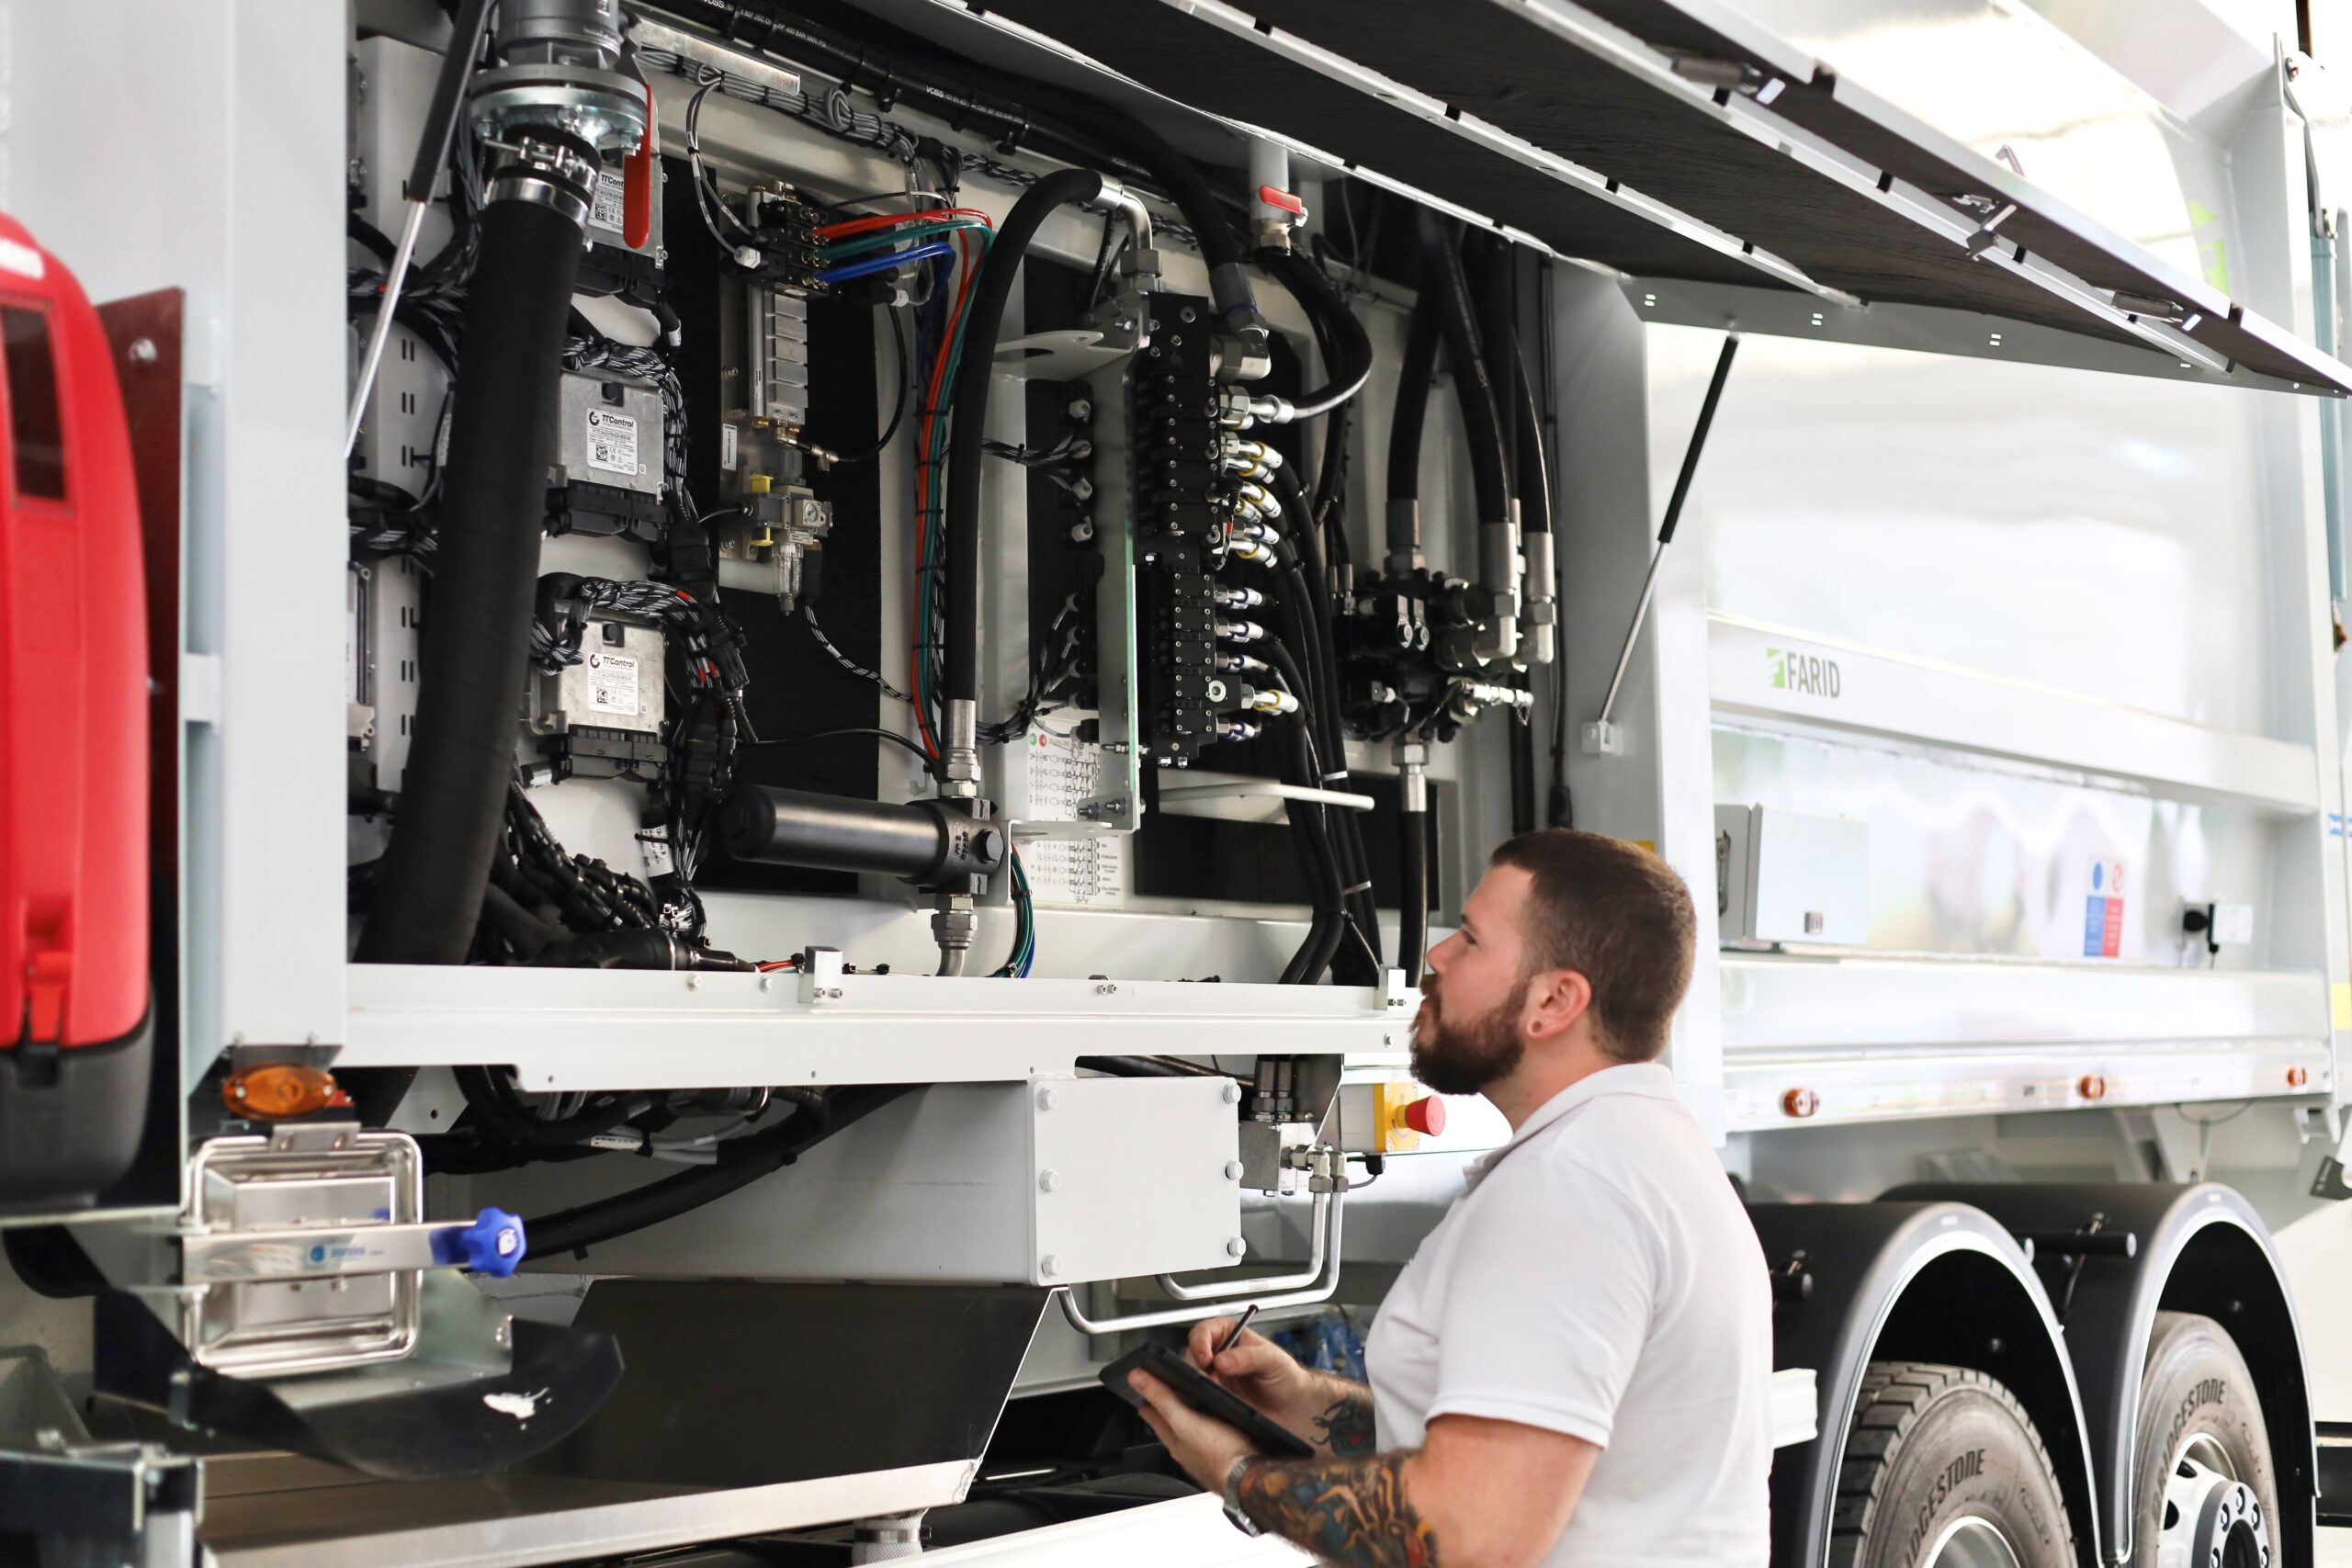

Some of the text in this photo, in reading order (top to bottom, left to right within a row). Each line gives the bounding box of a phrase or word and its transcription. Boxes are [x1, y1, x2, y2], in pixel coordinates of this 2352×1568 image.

[926, 85, 944, 98] VOSS
[601, 174, 625, 187] TTCont
[602, 413, 634, 428] TTControl
[603, 656, 635, 668] TTControl
[1787, 651, 1841, 699] FARID
[1905, 1448, 1986, 1568] IDGESTONE
